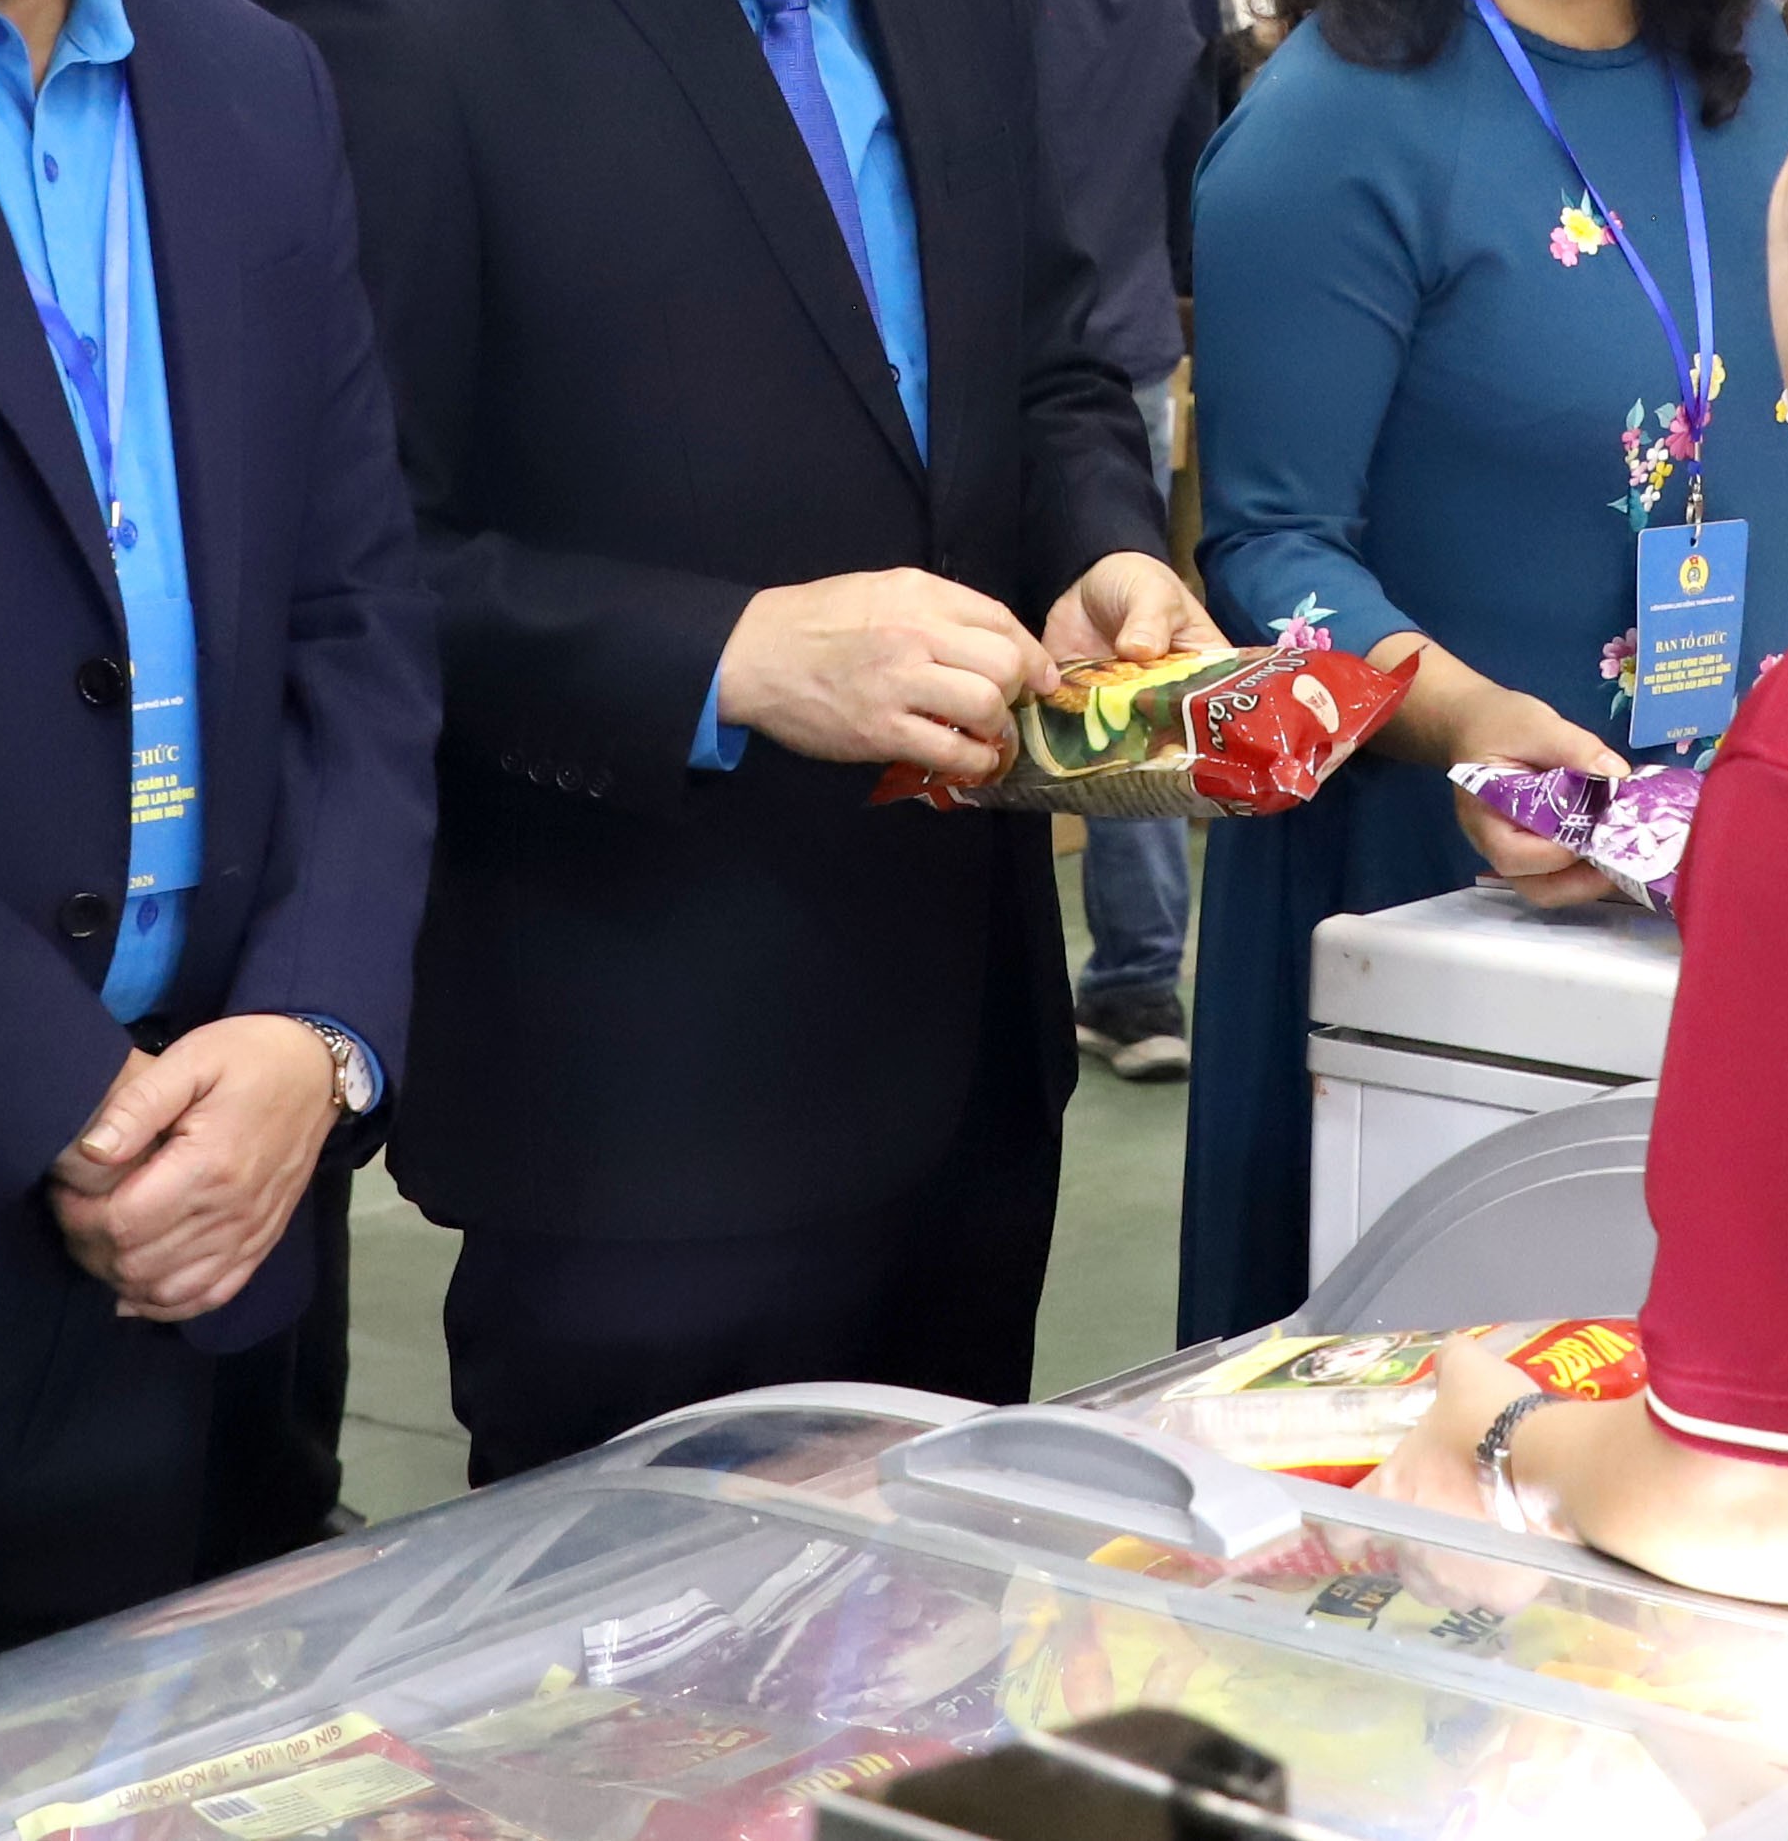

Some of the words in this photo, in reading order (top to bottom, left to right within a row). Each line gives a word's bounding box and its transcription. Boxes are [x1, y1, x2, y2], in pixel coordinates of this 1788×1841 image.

[1655, 640, 1678, 654] BAN
[1680, 631, 1696, 651] TỔ
[1697, 630, 1727, 648] CHỨC
